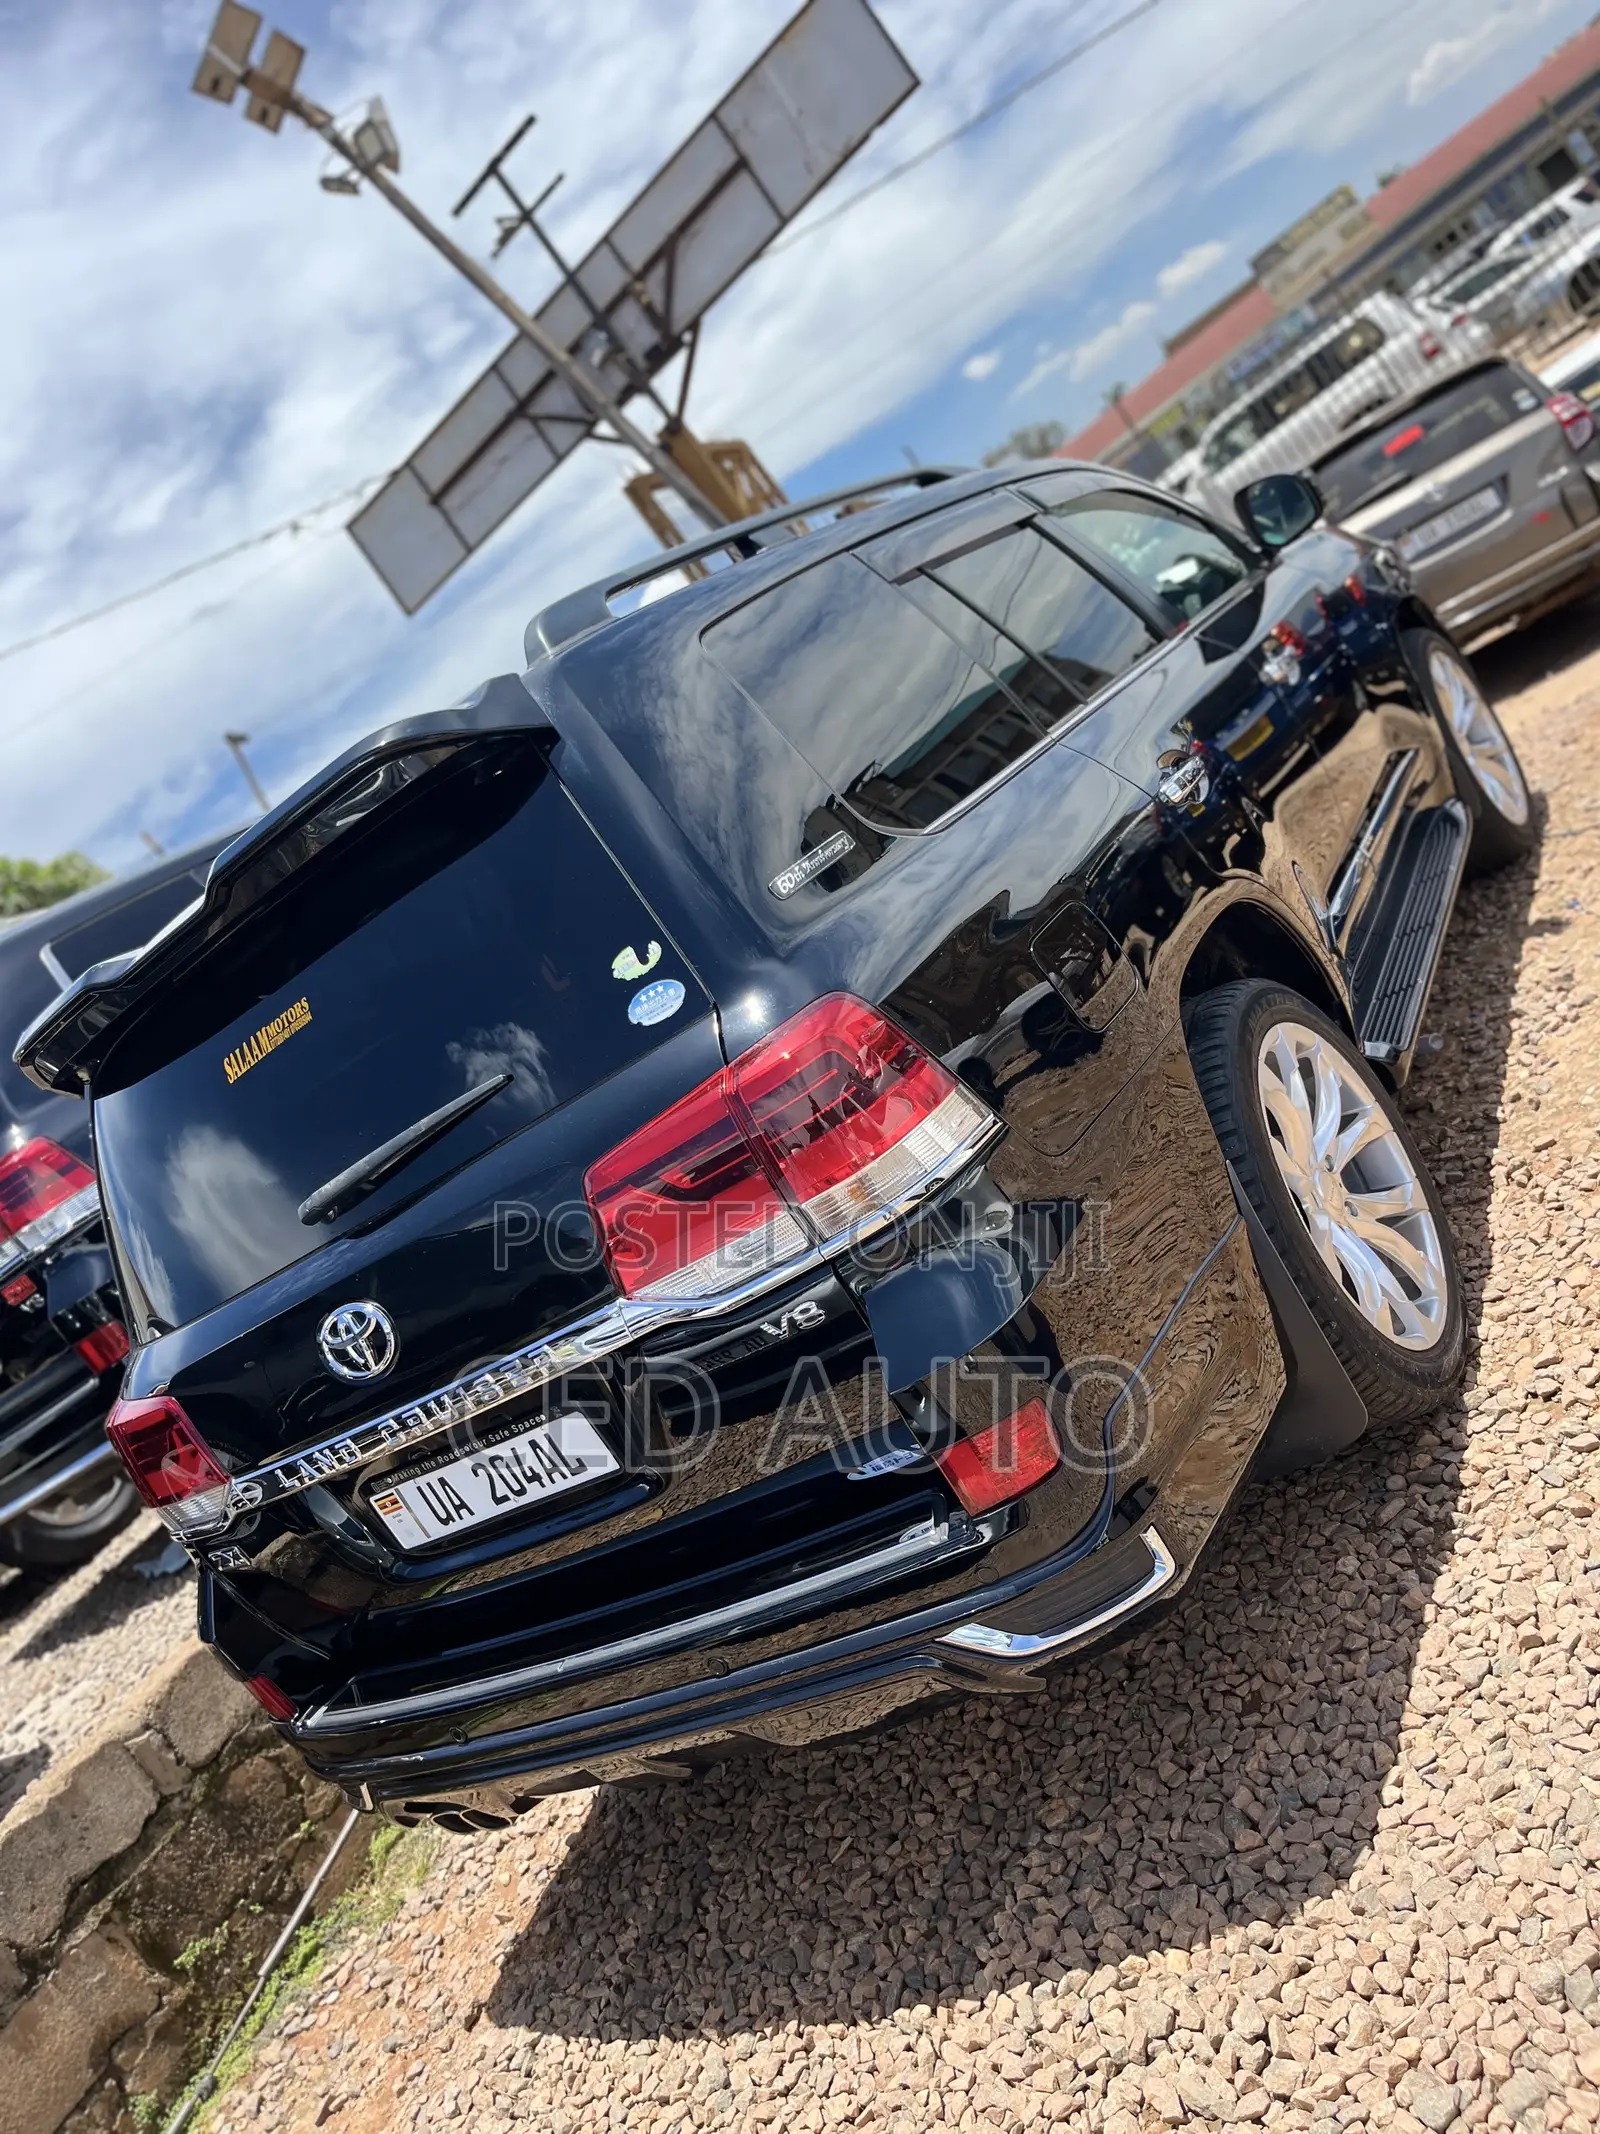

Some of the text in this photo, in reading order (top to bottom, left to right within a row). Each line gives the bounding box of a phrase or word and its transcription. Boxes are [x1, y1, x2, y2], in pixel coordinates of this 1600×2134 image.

[224, 1027, 272, 1084] SALAAM
[266, 997, 309, 1040] MOTORS
[760, 1300, 826, 1339] V8
[274, 1438, 362, 1489] LAND
[391, 1466, 422, 1484] Making
[421, 1460, 437, 1471] the
[488, 1428, 511, 1444] Safe
[511, 1417, 541, 1434] Space
[416, 1432, 588, 1526] UA 204AL
